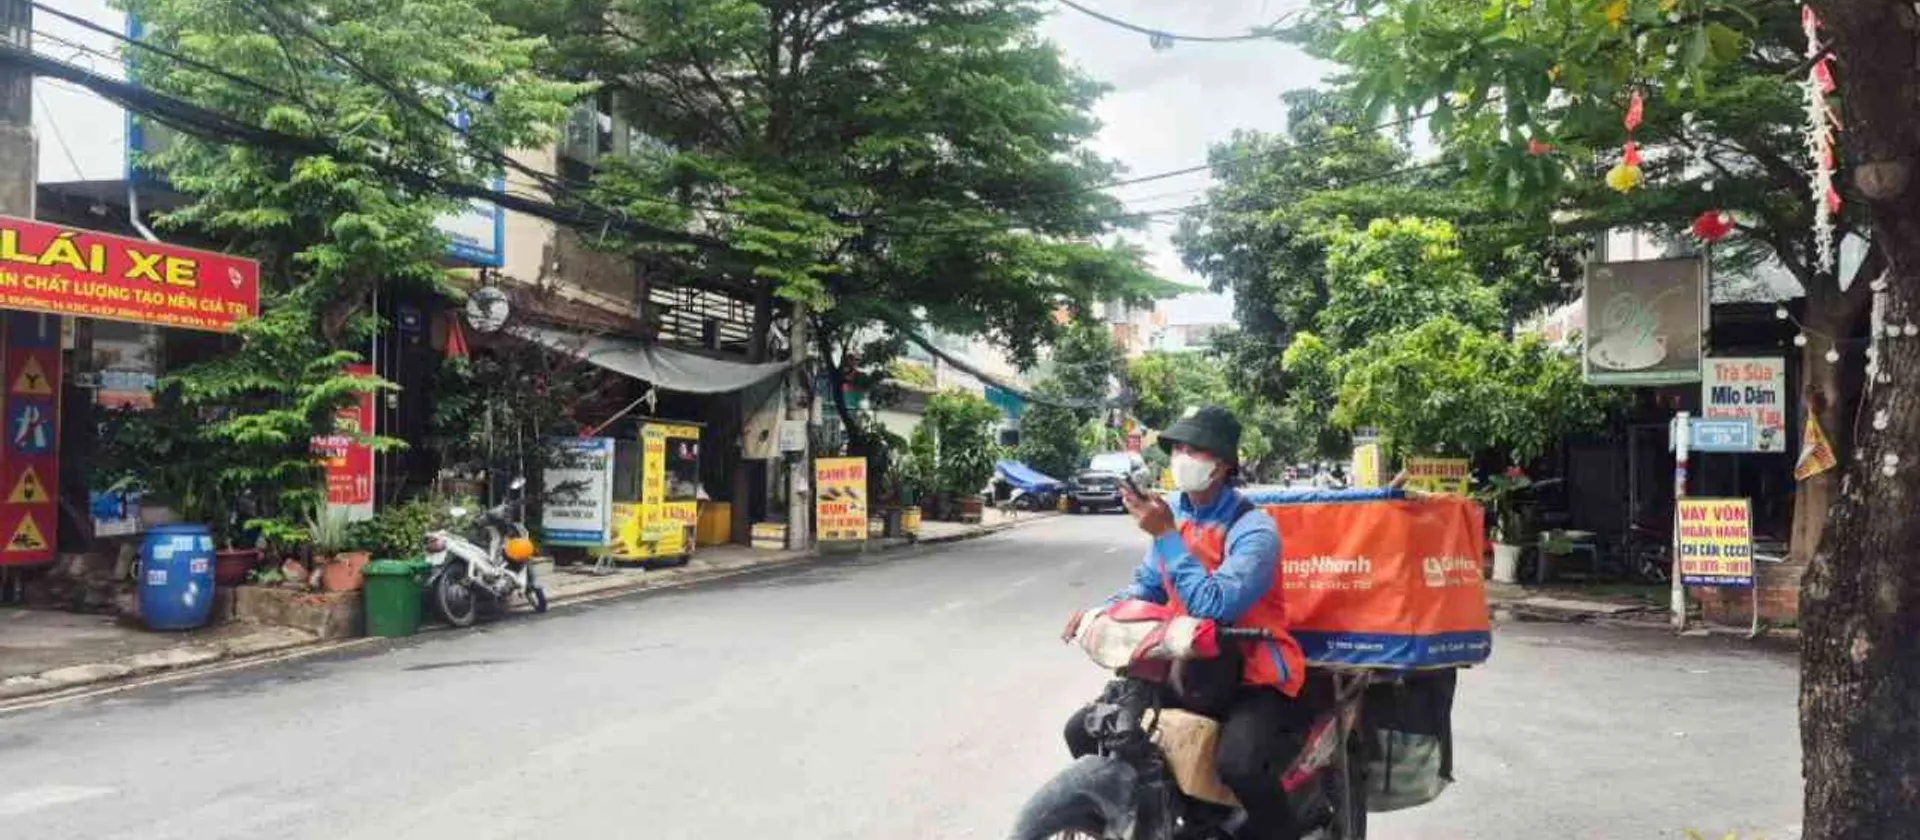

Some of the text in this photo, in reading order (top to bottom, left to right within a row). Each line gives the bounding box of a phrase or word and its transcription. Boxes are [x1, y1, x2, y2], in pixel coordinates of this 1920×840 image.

[1, 229, 197, 288] LÁI XE
[23, 273, 70, 293] CHẤT
[74, 281, 130, 302] LƯỢNG
[168, 291, 197, 310] NÊN
[1681, 505, 1707, 520] VAY
